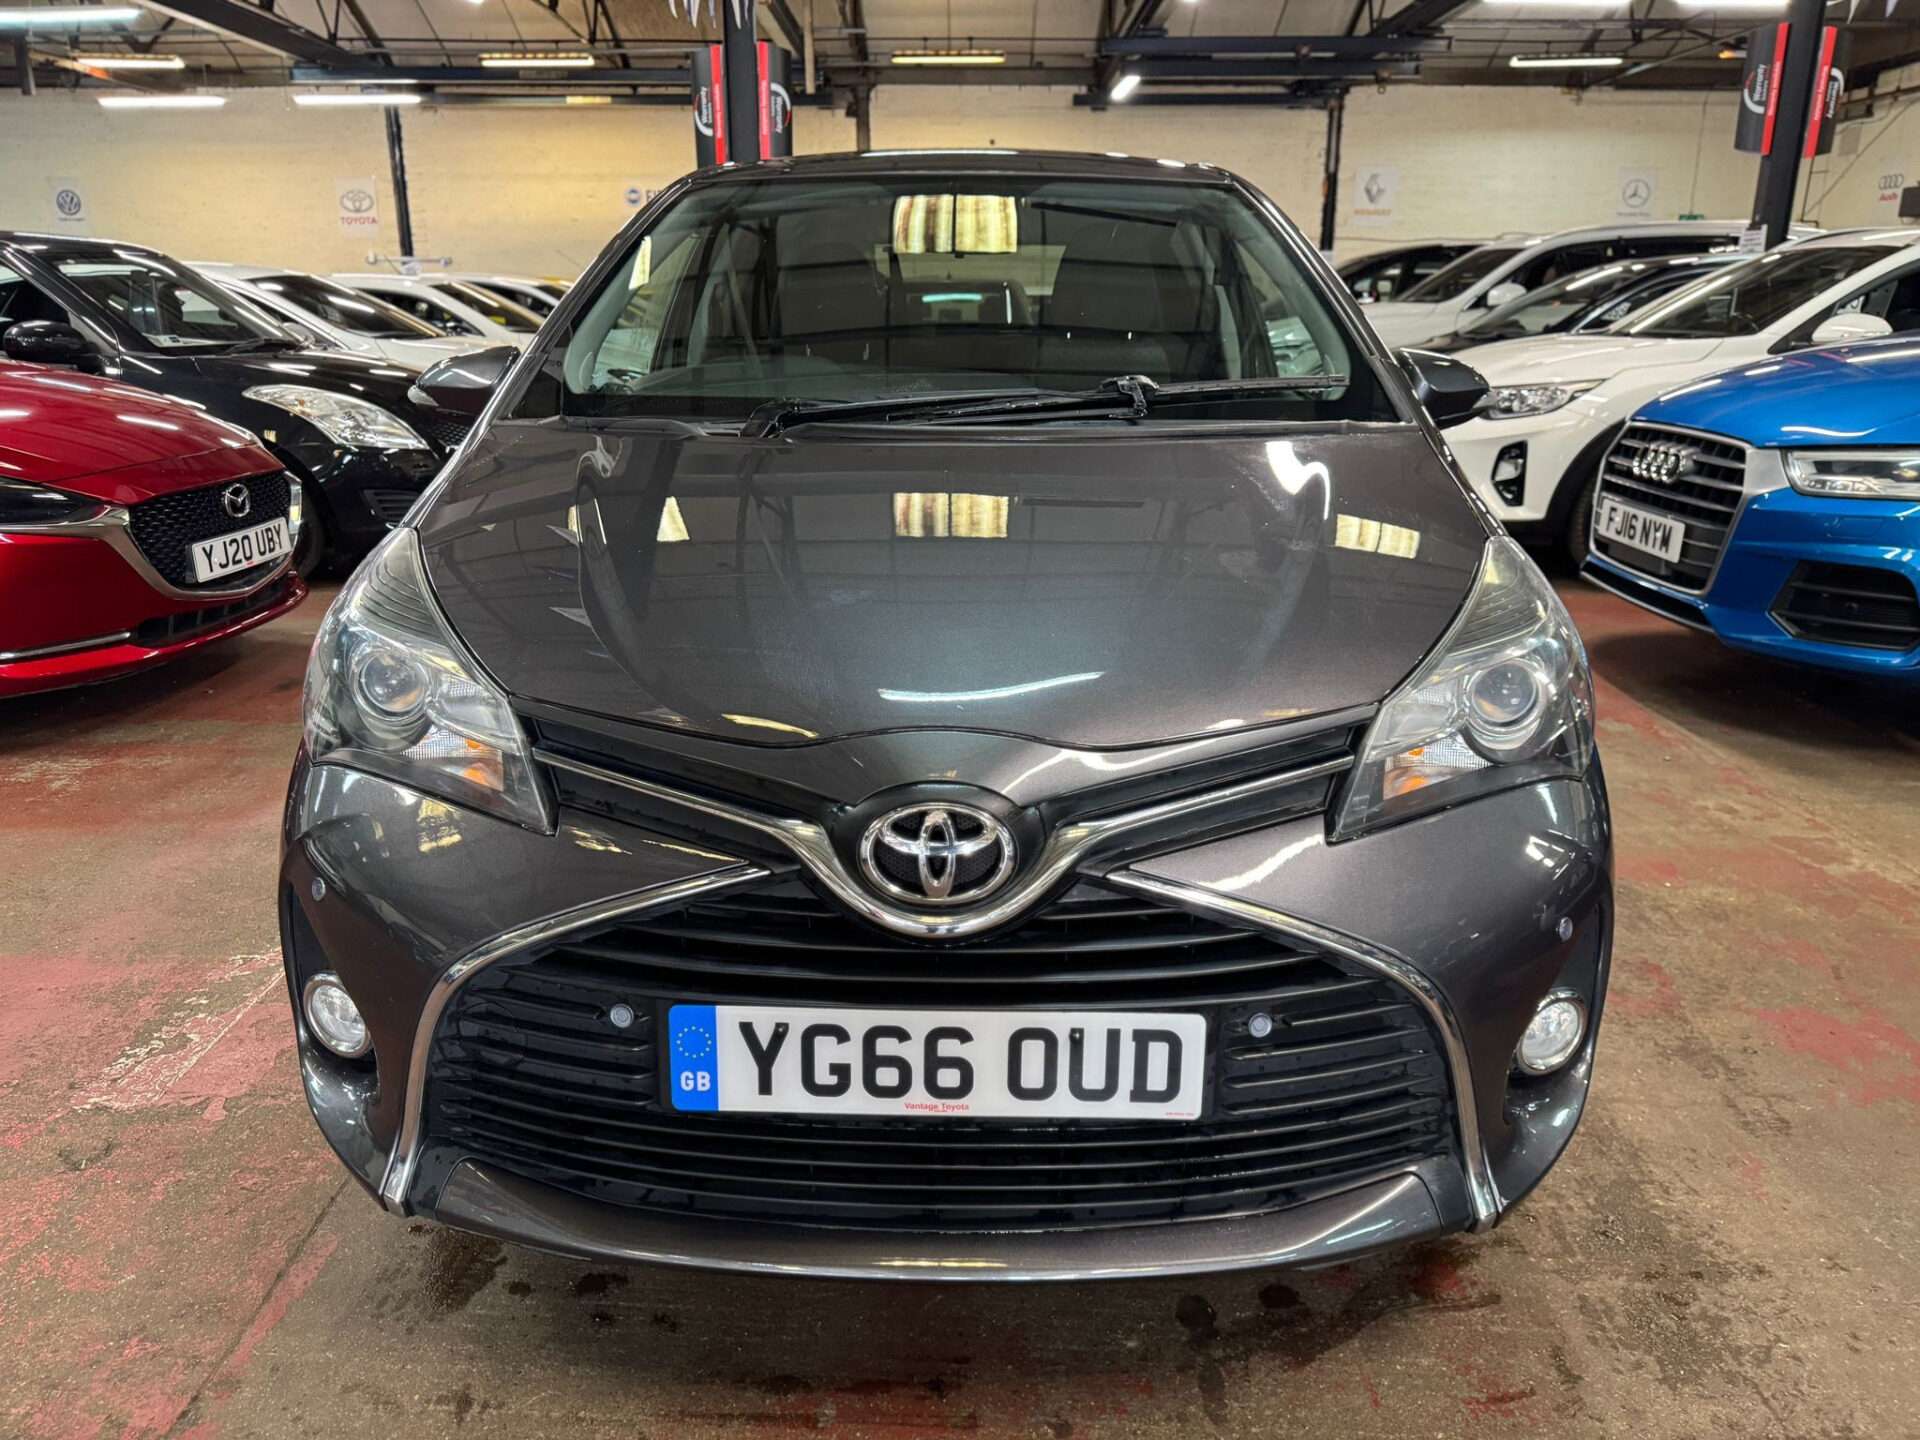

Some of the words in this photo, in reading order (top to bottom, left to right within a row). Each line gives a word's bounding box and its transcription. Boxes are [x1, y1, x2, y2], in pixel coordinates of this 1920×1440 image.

[340, 216, 378, 225] TOYOTA
[1606, 506, 1638, 540] FJ16
[202, 534, 253, 573] YJ20
[255, 523, 282, 556] UBY
[738, 1021, 974, 1100] YG66
[1007, 1027, 1183, 1103] OUD
[680, 1071, 711, 1092] GB
[904, 1103, 938, 1112] Vantage
[942, 1103, 969, 1112] Toyota
